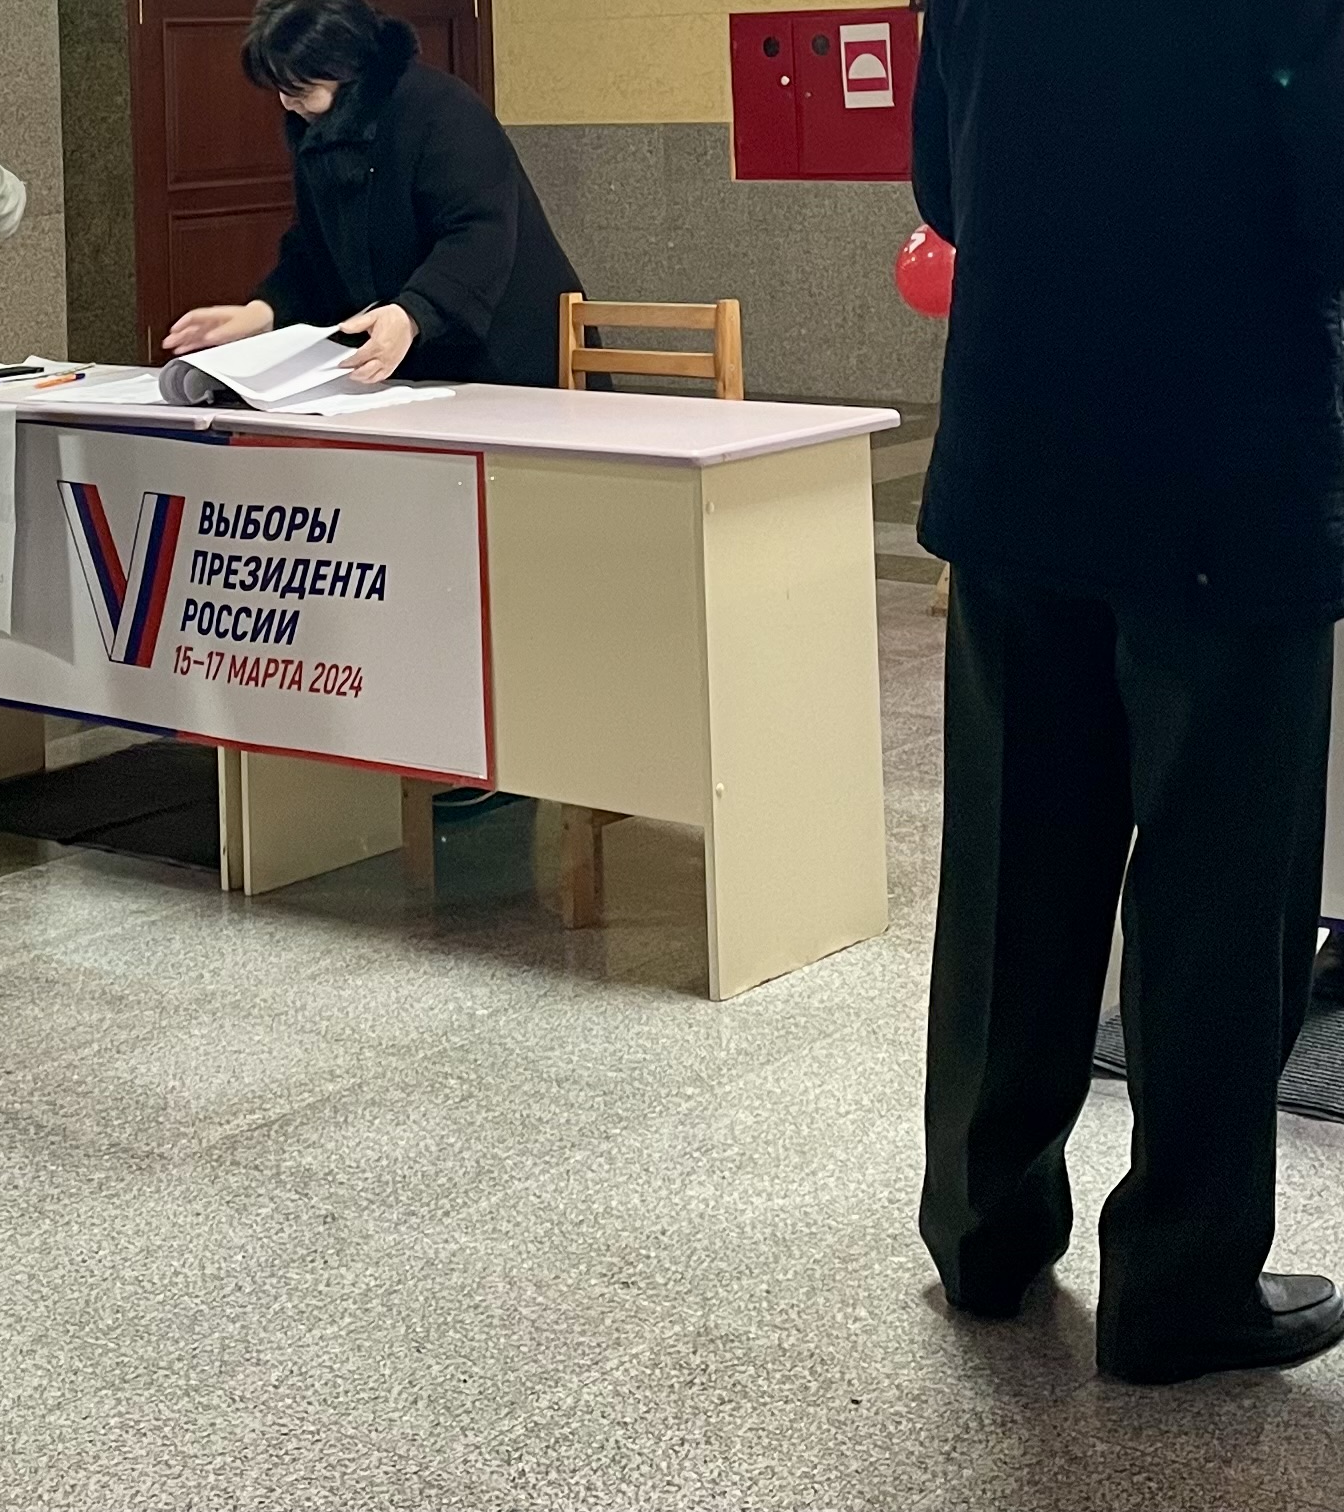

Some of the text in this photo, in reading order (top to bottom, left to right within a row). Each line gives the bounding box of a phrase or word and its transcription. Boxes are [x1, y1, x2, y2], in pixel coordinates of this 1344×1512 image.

[198, 501, 341, 544] ВЫБОРЫ
[190, 550, 387, 601] ПРЕЗИДЕНТА
[180, 598, 301, 645] РОССИИ
[227, 655, 304, 692] МАРТА
[308, 662, 363, 698] 2024
